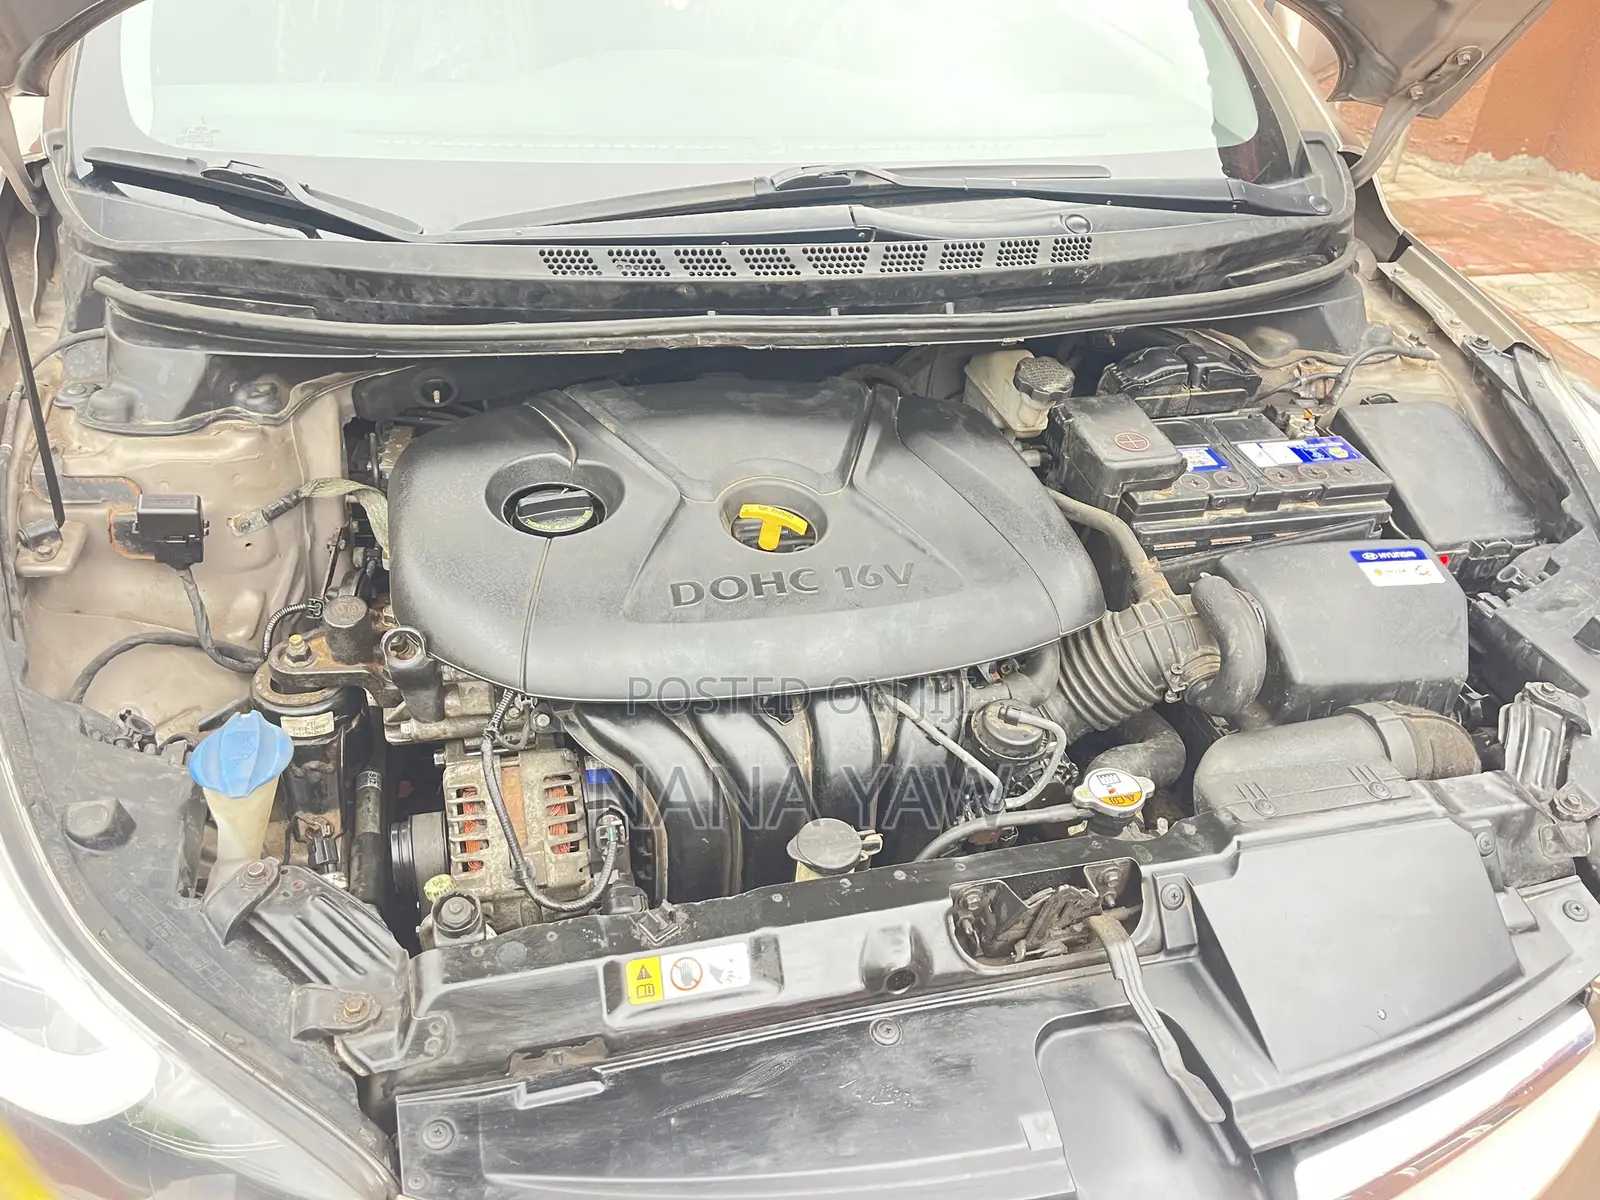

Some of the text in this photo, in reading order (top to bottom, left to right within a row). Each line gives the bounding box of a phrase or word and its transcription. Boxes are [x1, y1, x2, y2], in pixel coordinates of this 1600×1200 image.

[1376, 550, 1417, 559] HYUNDAI
[669, 562, 914, 608] DOHC 16V
